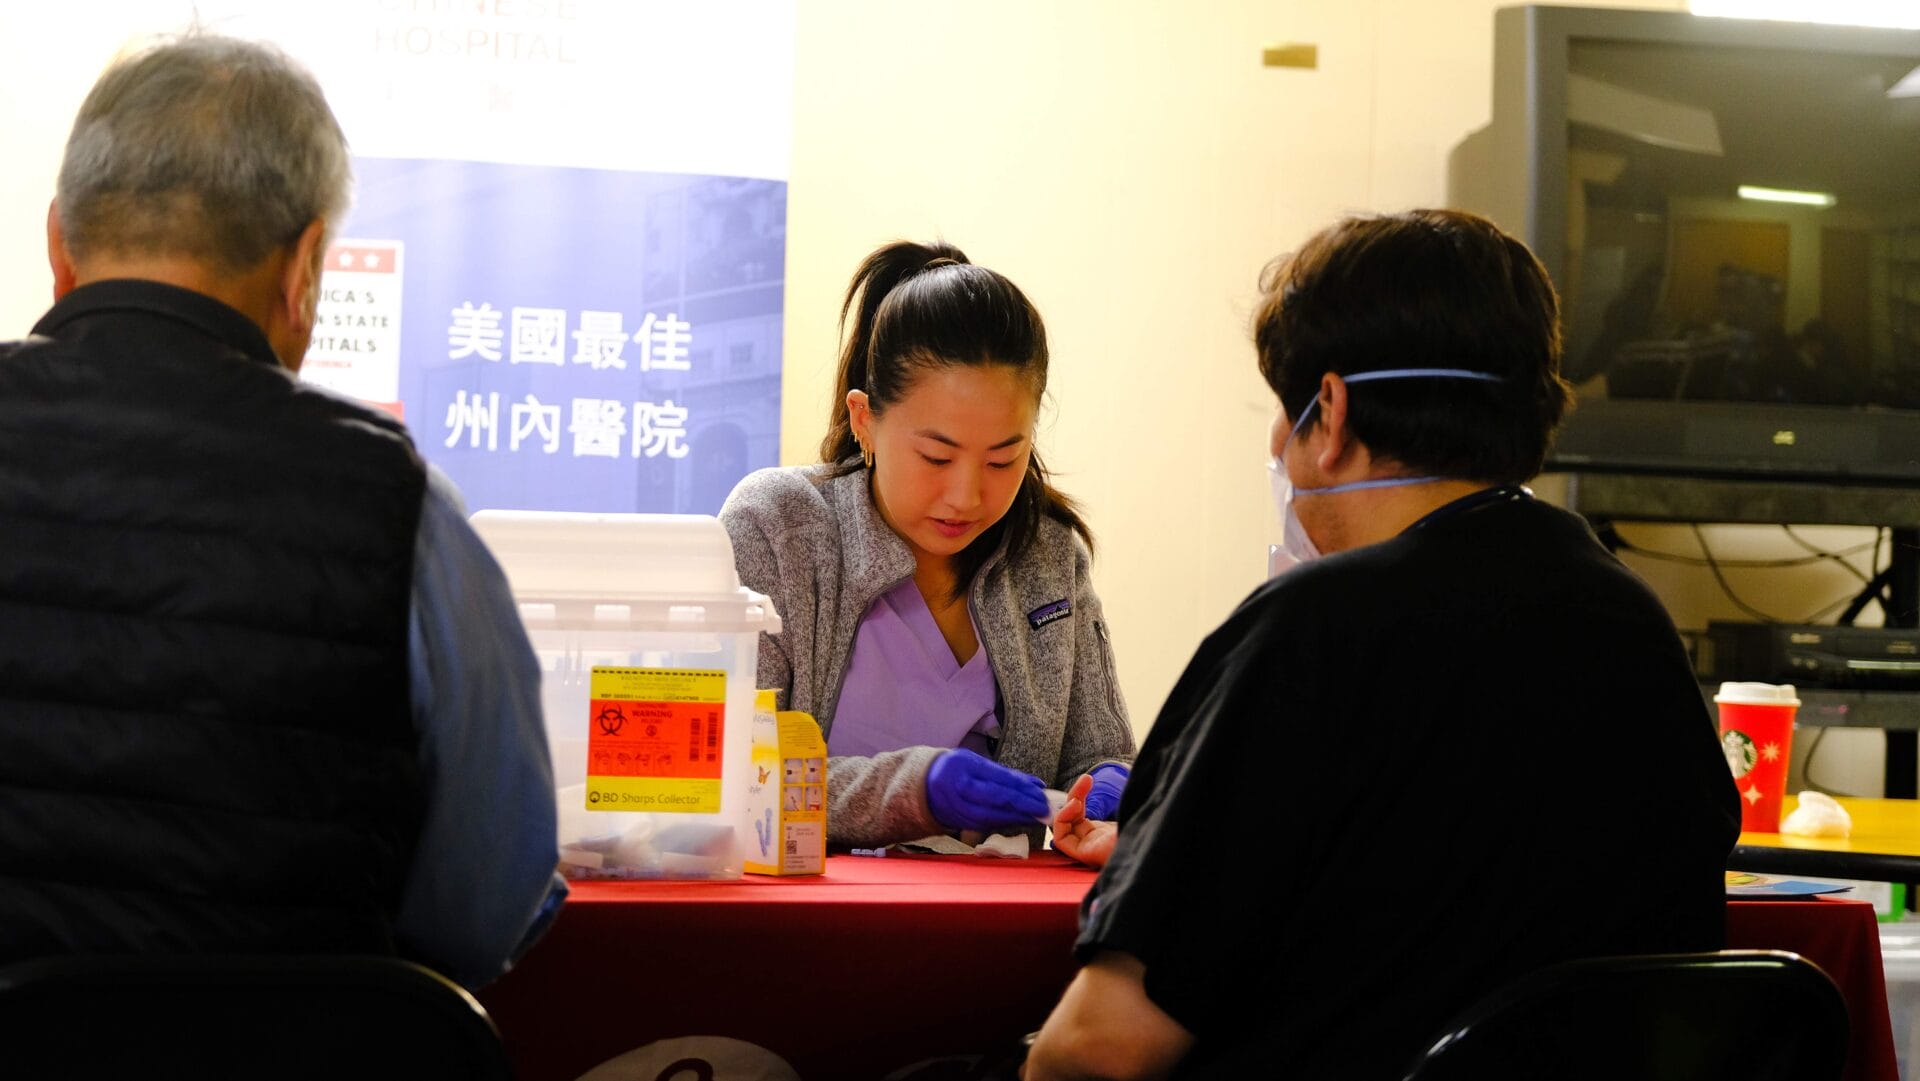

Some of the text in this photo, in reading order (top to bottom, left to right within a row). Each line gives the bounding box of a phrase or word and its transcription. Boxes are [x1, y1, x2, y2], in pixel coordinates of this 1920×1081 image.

[375, 26, 577, 64] HOSPITAL
[447, 300, 693, 372] 美國最佳
[444, 390, 690, 458] 州內醫院
[1036, 608, 1069, 626] patagonia
[632, 710, 673, 718] WARNING
[602, 792, 701, 805] BD Sharps Collector
